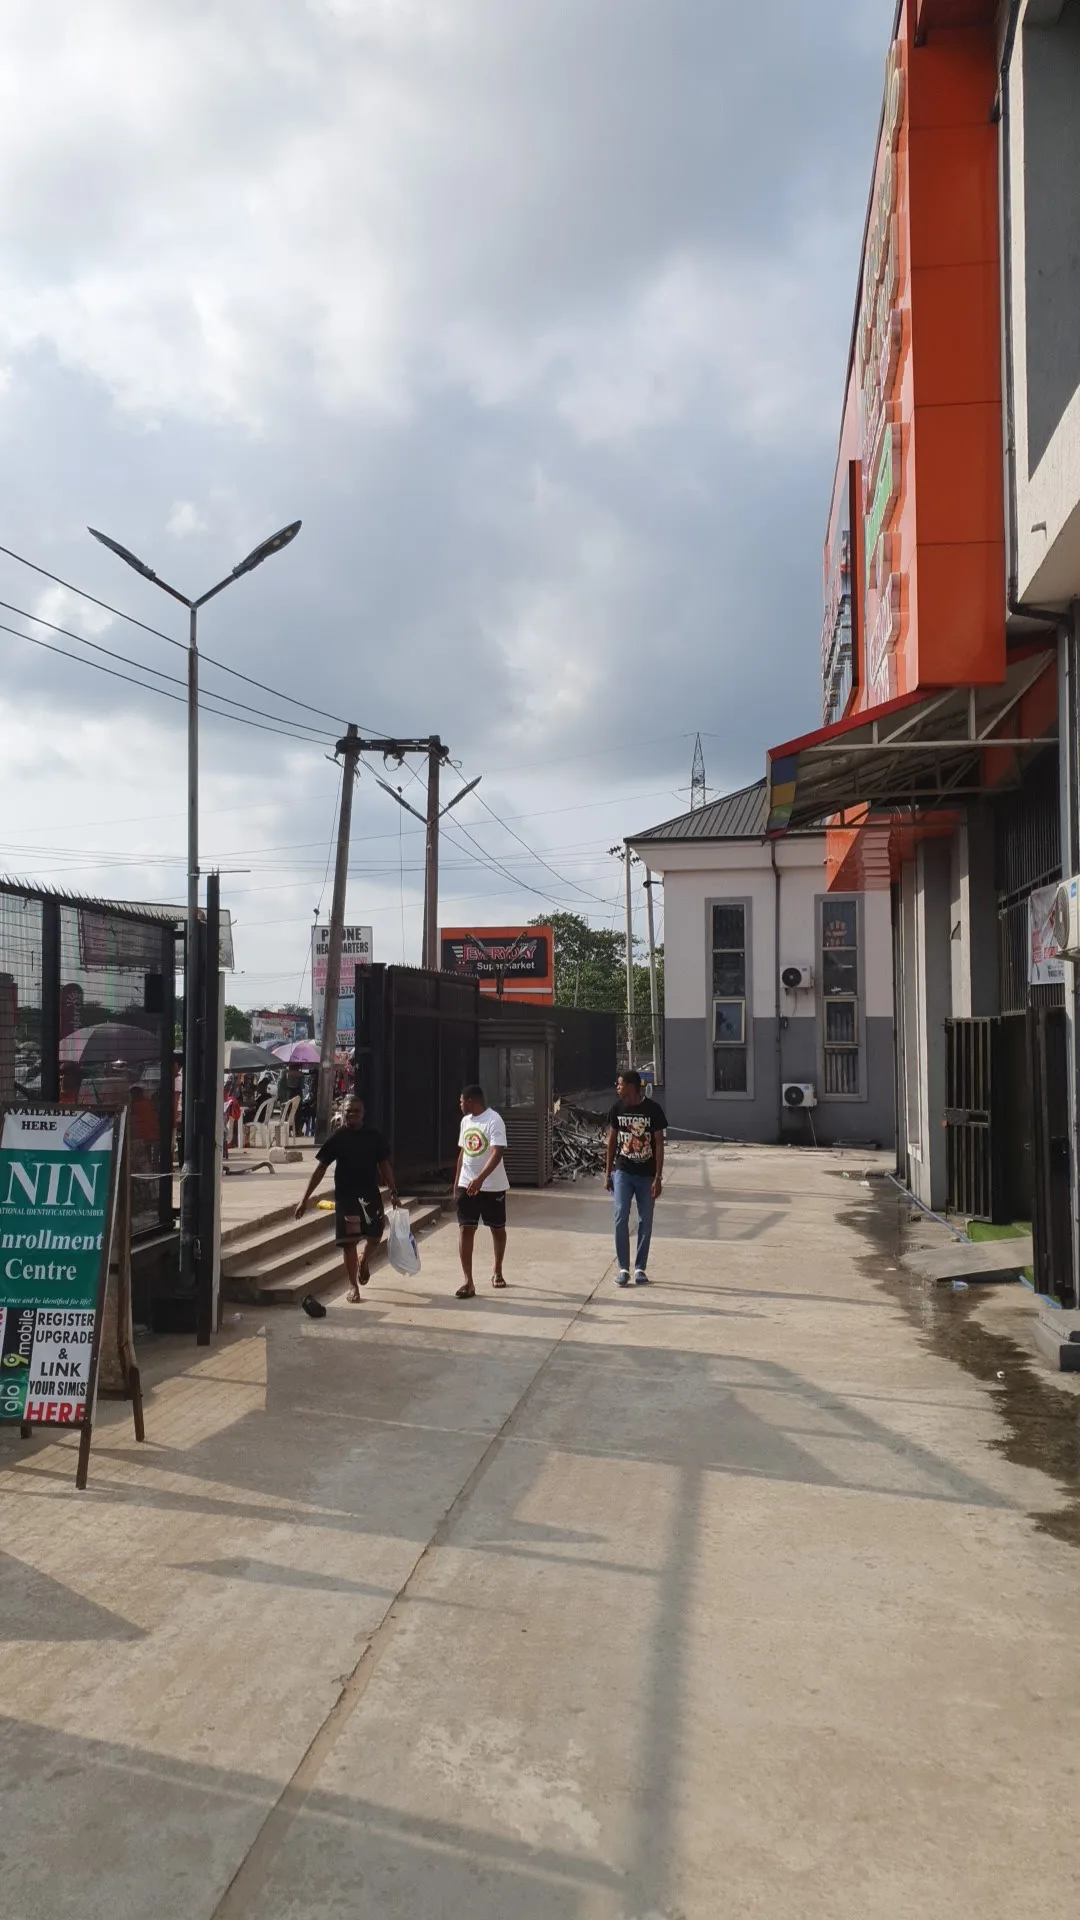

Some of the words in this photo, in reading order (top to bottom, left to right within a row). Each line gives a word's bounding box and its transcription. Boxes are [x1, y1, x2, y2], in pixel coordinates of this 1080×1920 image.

[321, 928, 361, 942] PONE
[316, 942, 369, 955] HEAARTERS
[4, 1107, 78, 1117] AVAILABLE
[21, 1120, 58, 1131] HERE
[3, 1161, 102, 1206] NIN
[26, 1208, 79, 1217] IDENTIFICATION
[78, 1209, 104, 1217] NUMBER
[0, 1228, 104, 1250] nrollment
[5, 1258, 77, 1280] Centre
[42, 1297, 69, 1306] identified
[37, 1312, 94, 1327] REGISTER
[35, 1330, 94, 1344] UPGRADE
[58, 1348, 68, 1359] &
[40, 1361, 82, 1377] LINK
[29, 1380, 55, 1395] YOUR
[0, 1385, 24, 1412] glo
[25, 1401, 87, 1422] HERE
